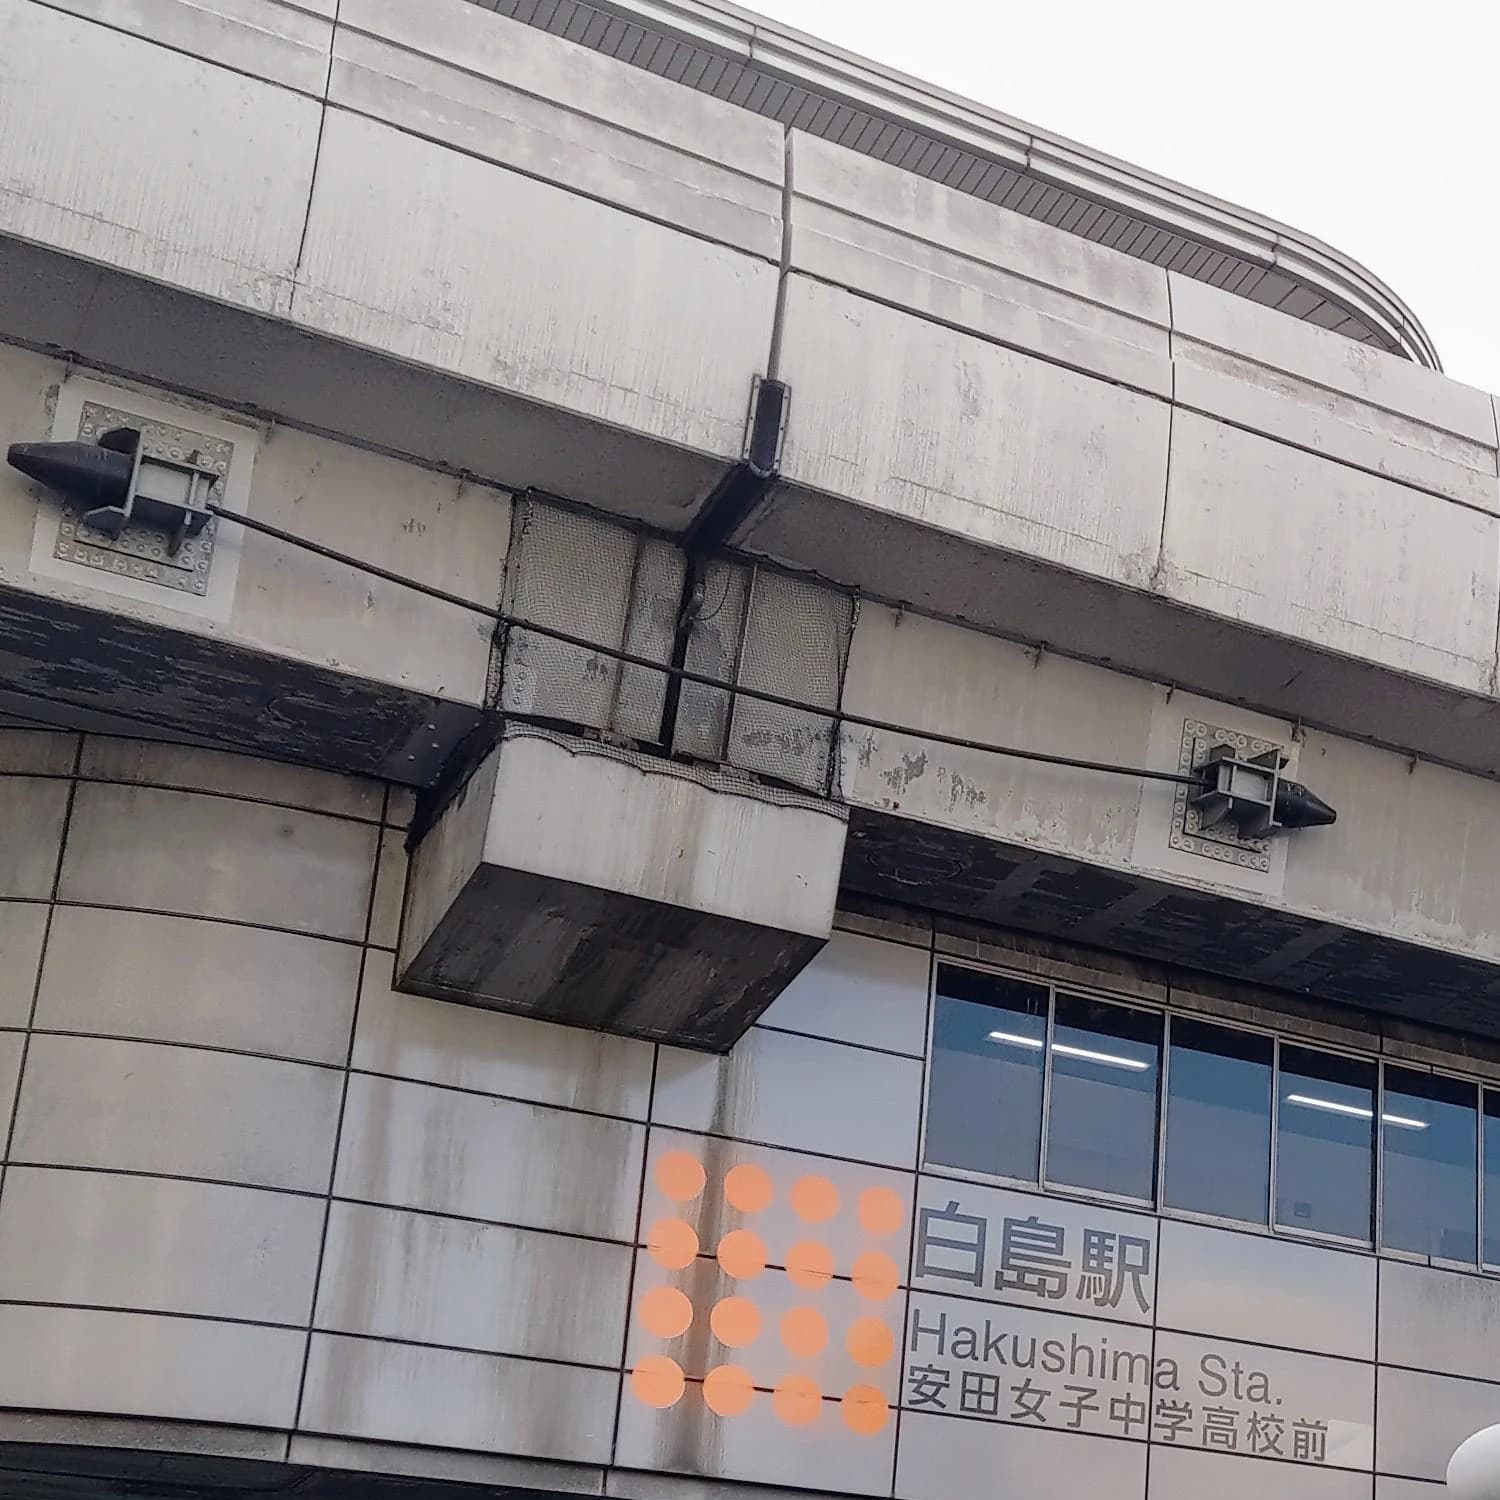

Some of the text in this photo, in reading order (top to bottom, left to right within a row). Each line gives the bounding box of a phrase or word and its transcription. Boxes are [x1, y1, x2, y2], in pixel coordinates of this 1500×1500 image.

[915, 1200, 1151, 1314] 白島駅
[910, 1308, 1282, 1406] Hakushima Sta.
[907, 1363, 1329, 1462] 安田女子中学高校前
